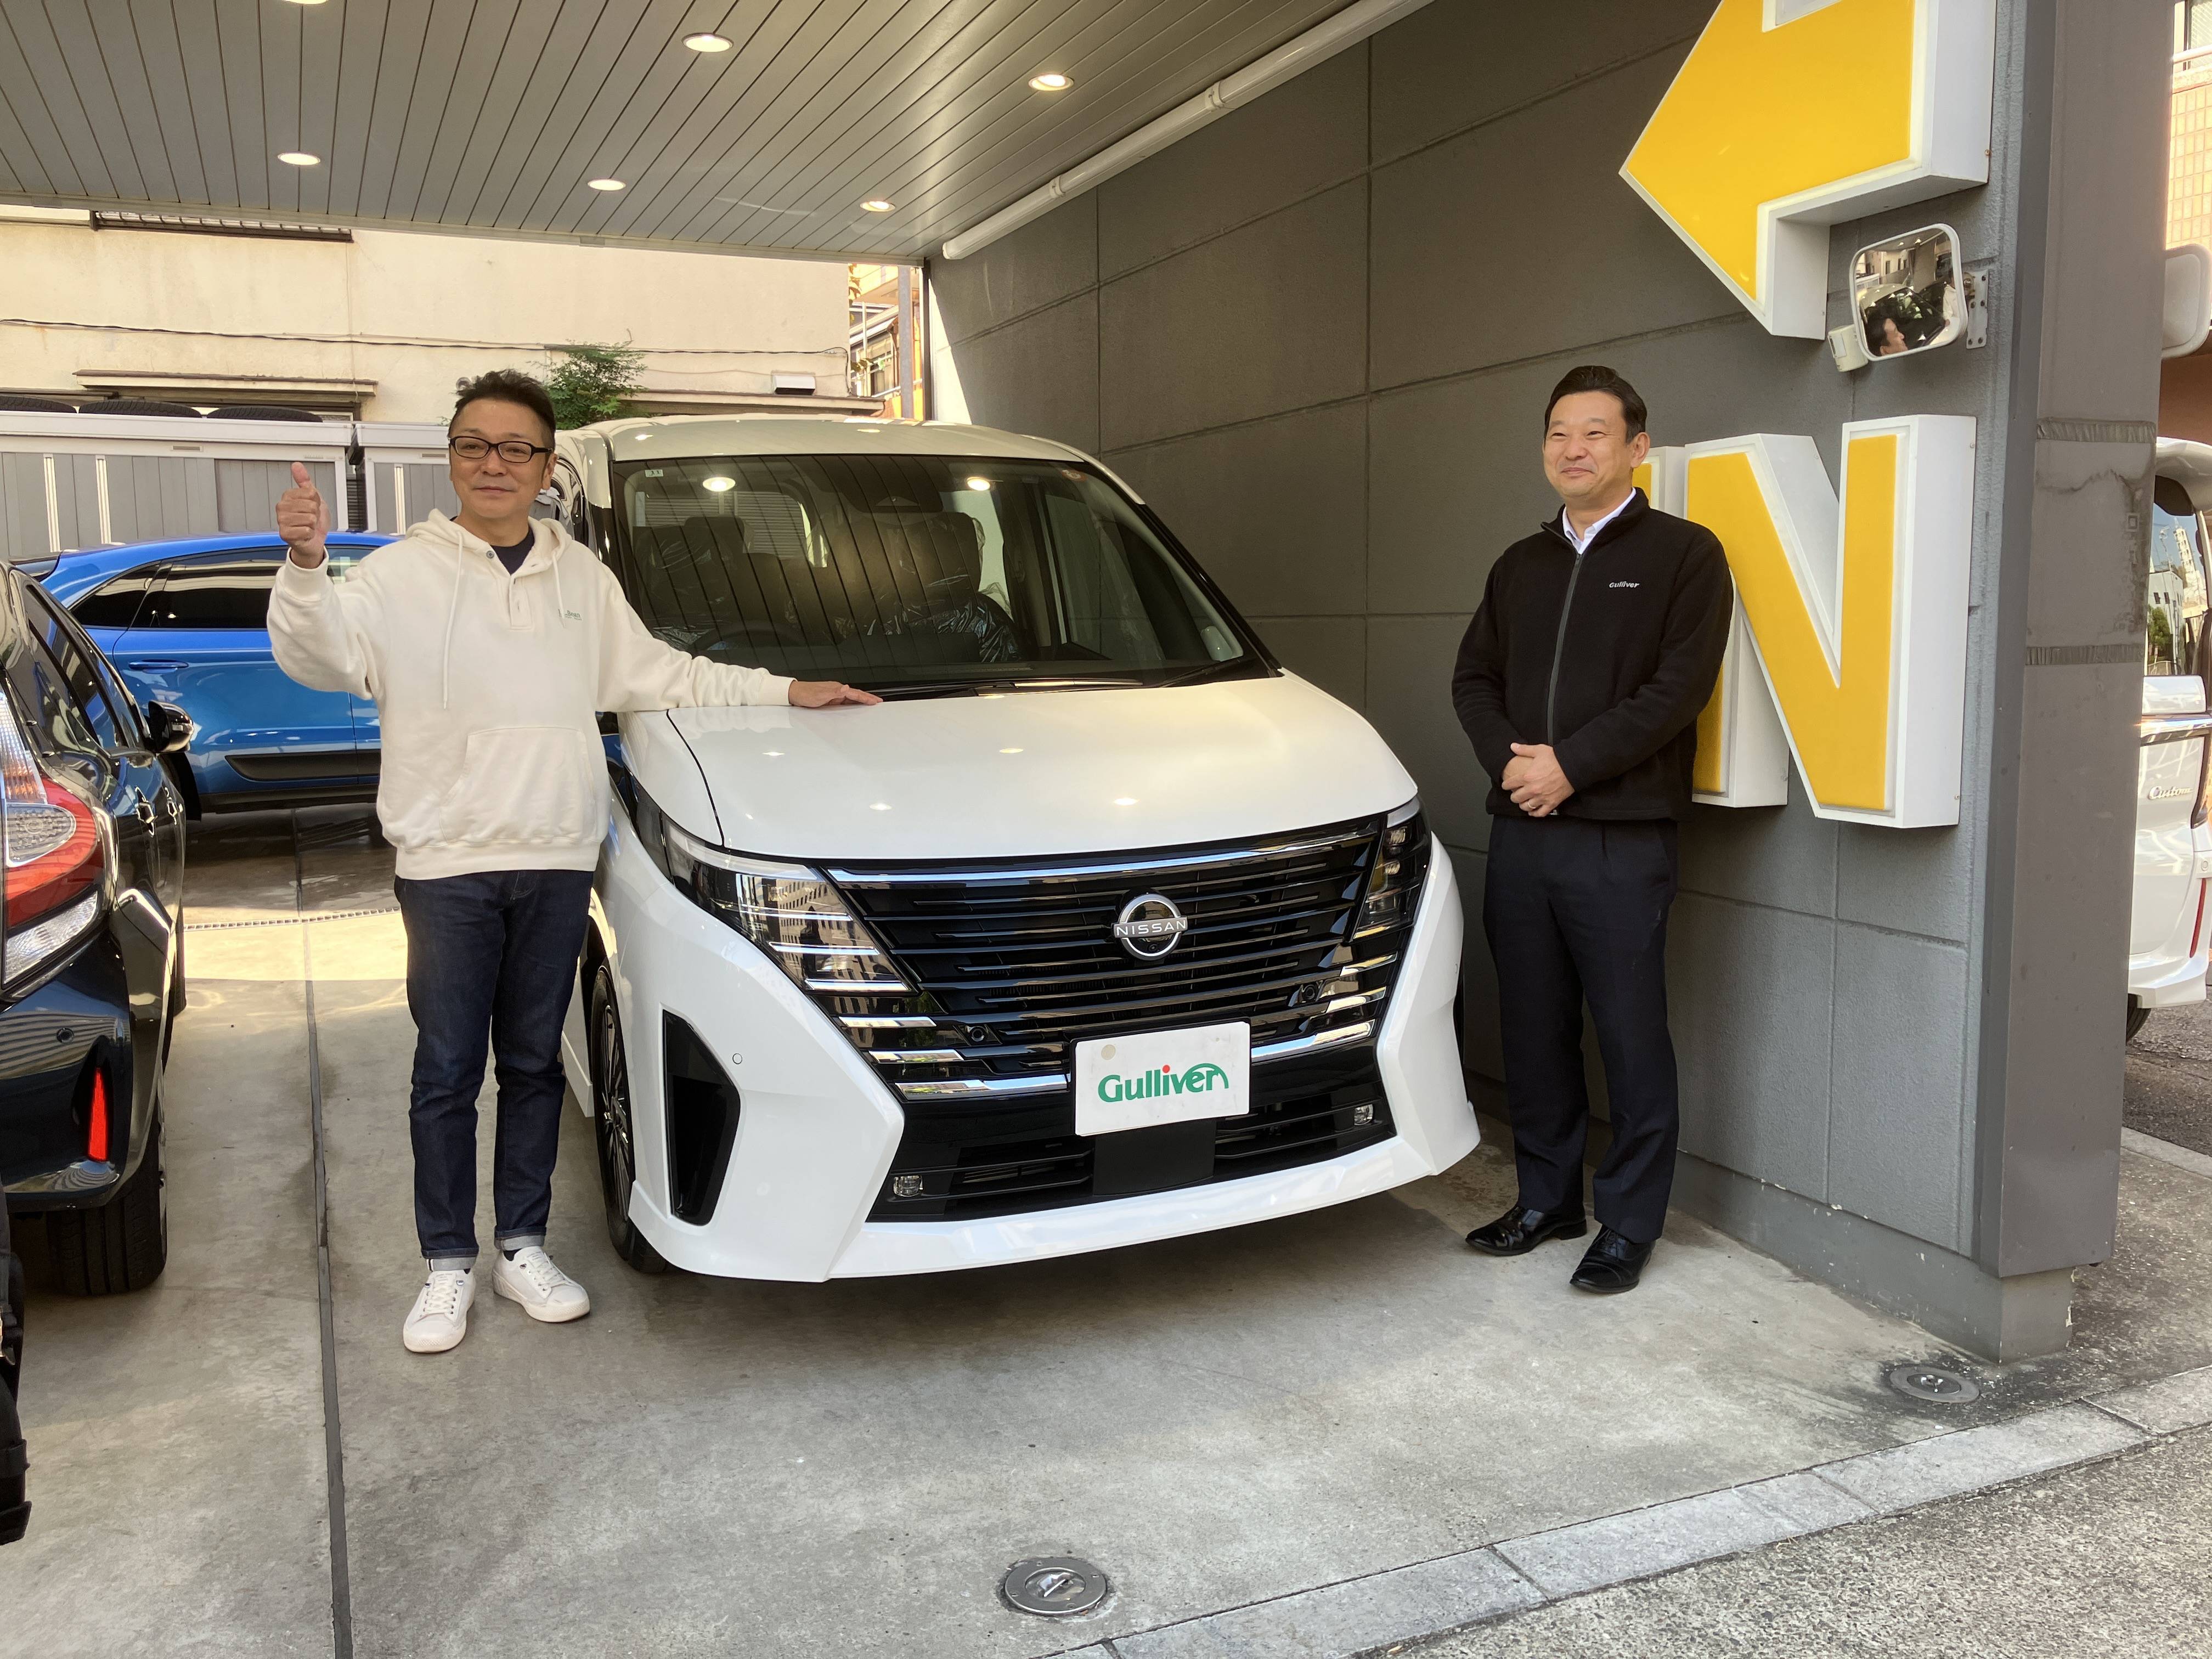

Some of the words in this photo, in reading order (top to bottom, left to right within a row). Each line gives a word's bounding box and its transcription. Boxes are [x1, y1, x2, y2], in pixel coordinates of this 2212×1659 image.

[1635, 414, 1977, 828] N
[2149, 786, 2194, 799] Custom
[1116, 920, 1186, 936] NISSAN
[1098, 1063, 1229, 1102] Gulliver
